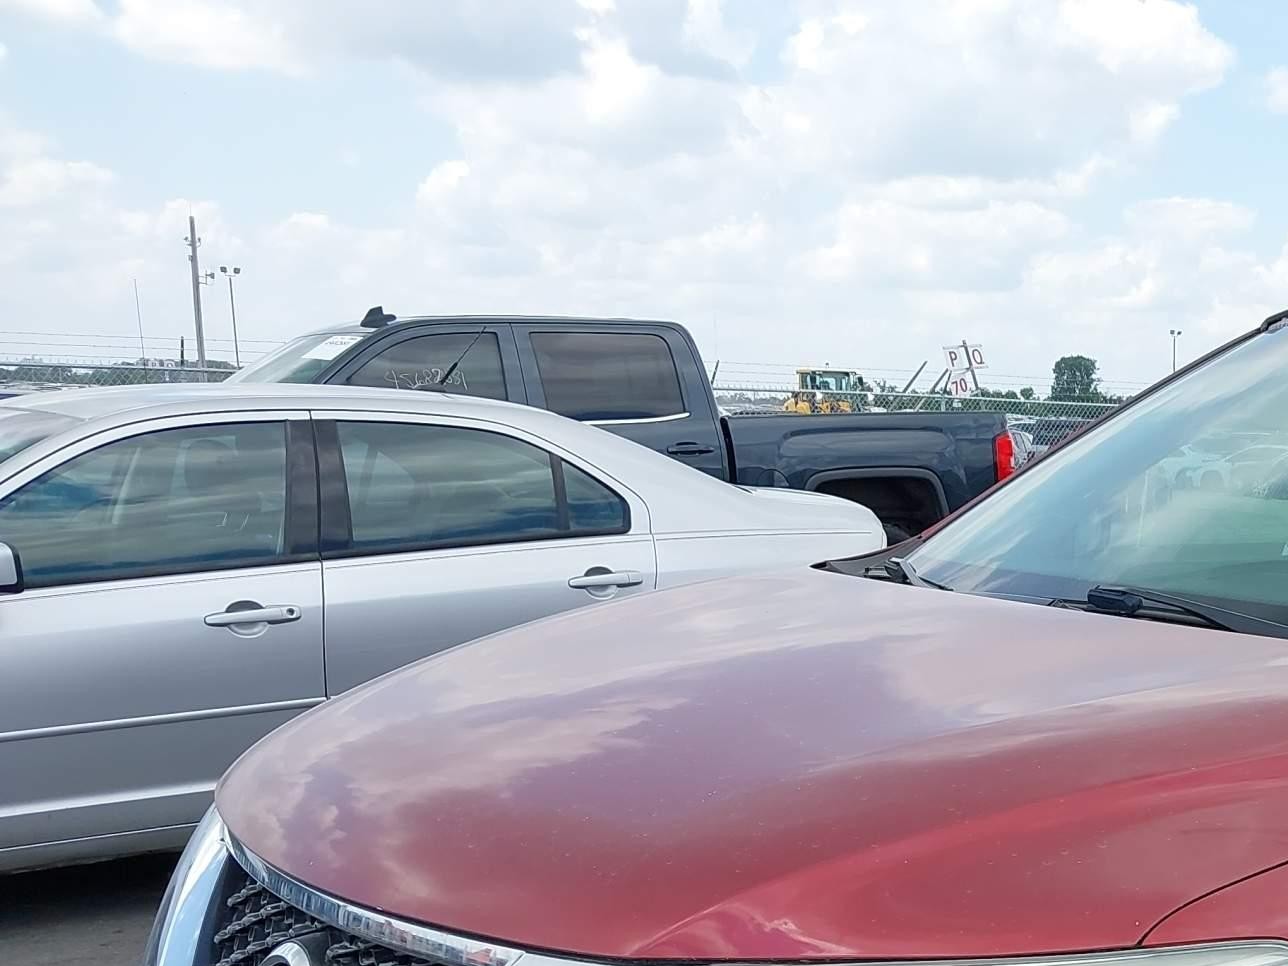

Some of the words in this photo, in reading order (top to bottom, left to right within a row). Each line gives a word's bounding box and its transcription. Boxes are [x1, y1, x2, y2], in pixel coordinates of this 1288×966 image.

[948, 350, 958, 368] P
[971, 348, 985, 365] Q
[951, 377, 968, 396] 70
